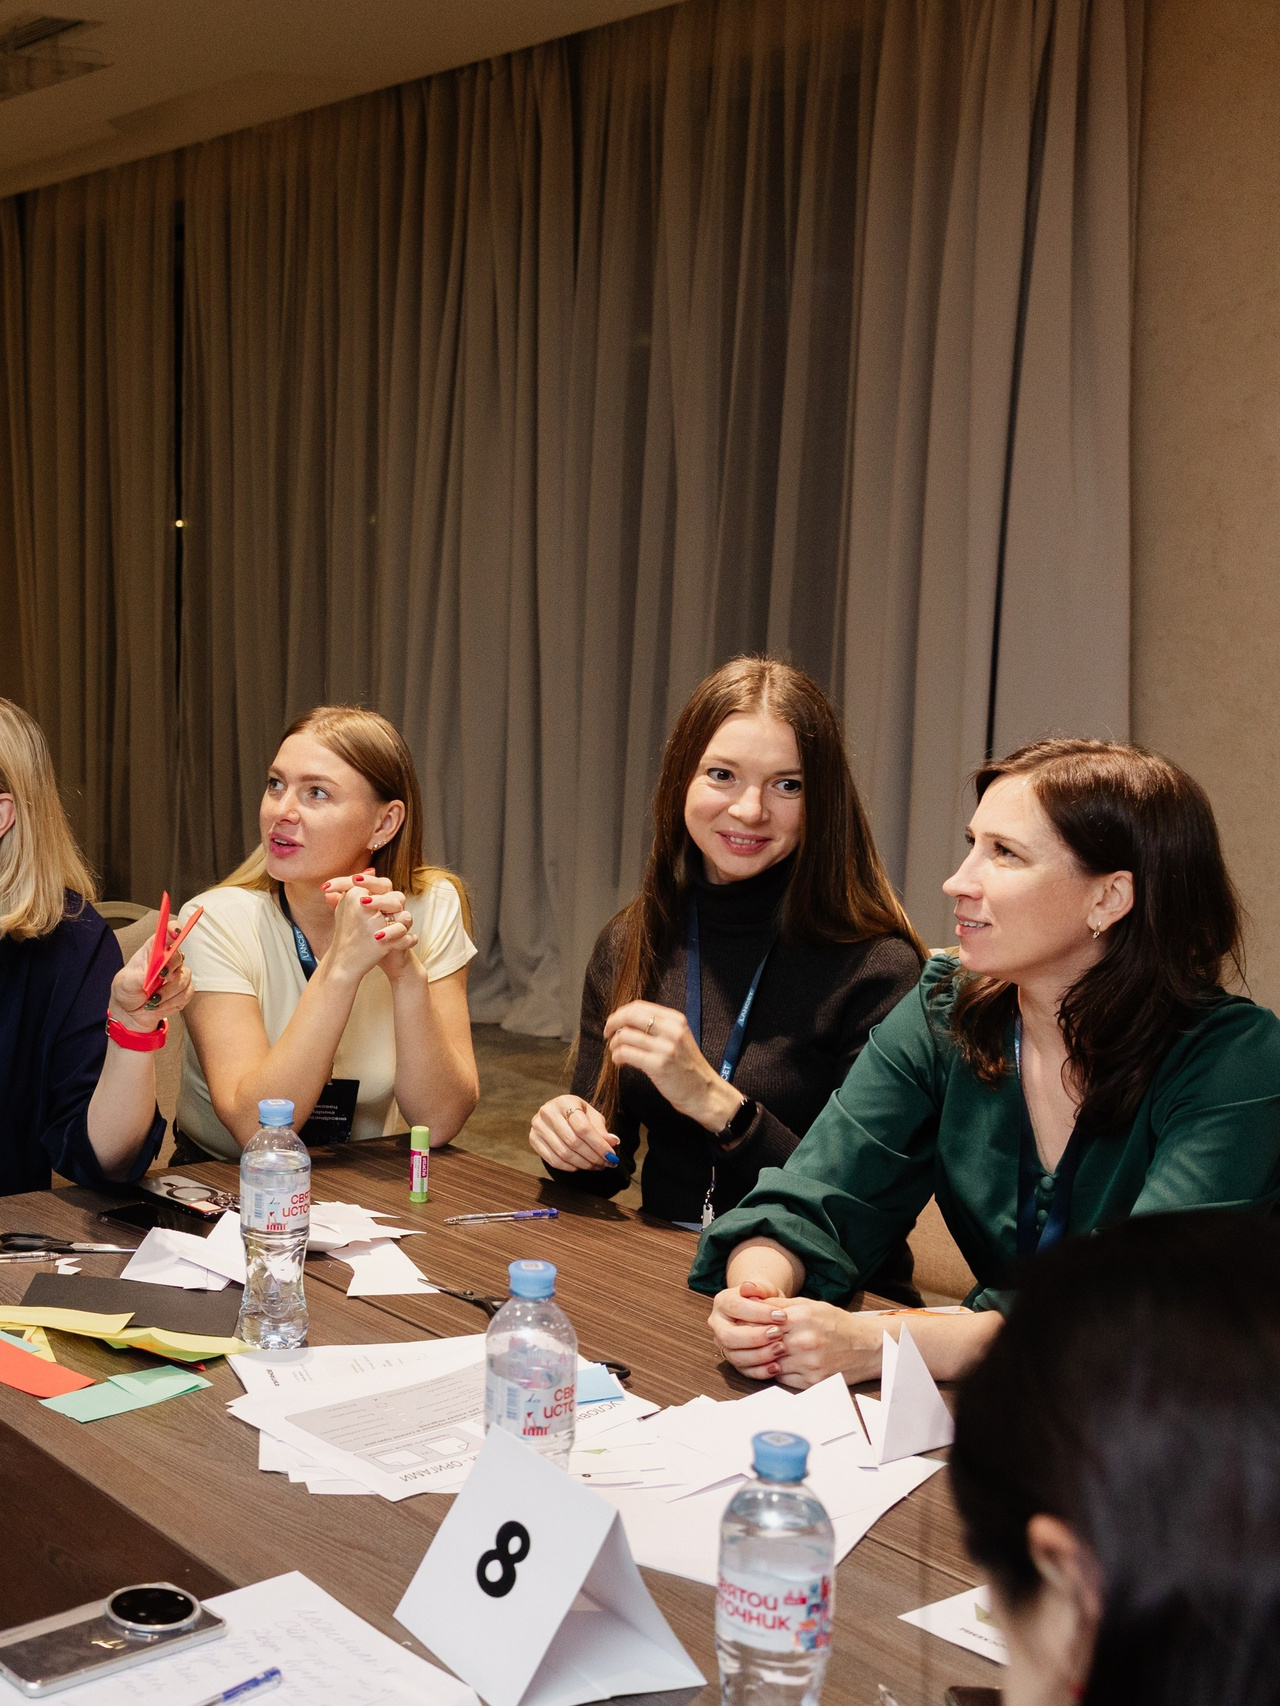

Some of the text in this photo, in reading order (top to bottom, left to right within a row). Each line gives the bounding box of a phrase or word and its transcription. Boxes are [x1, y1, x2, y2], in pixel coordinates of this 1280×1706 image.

[294, 929, 309, 959] LANCET
[740, 990, 753, 1022] LANCET
[399, 1460, 463, 1483] ОРИГАМИ
[476, 1521, 531, 1598] 8
